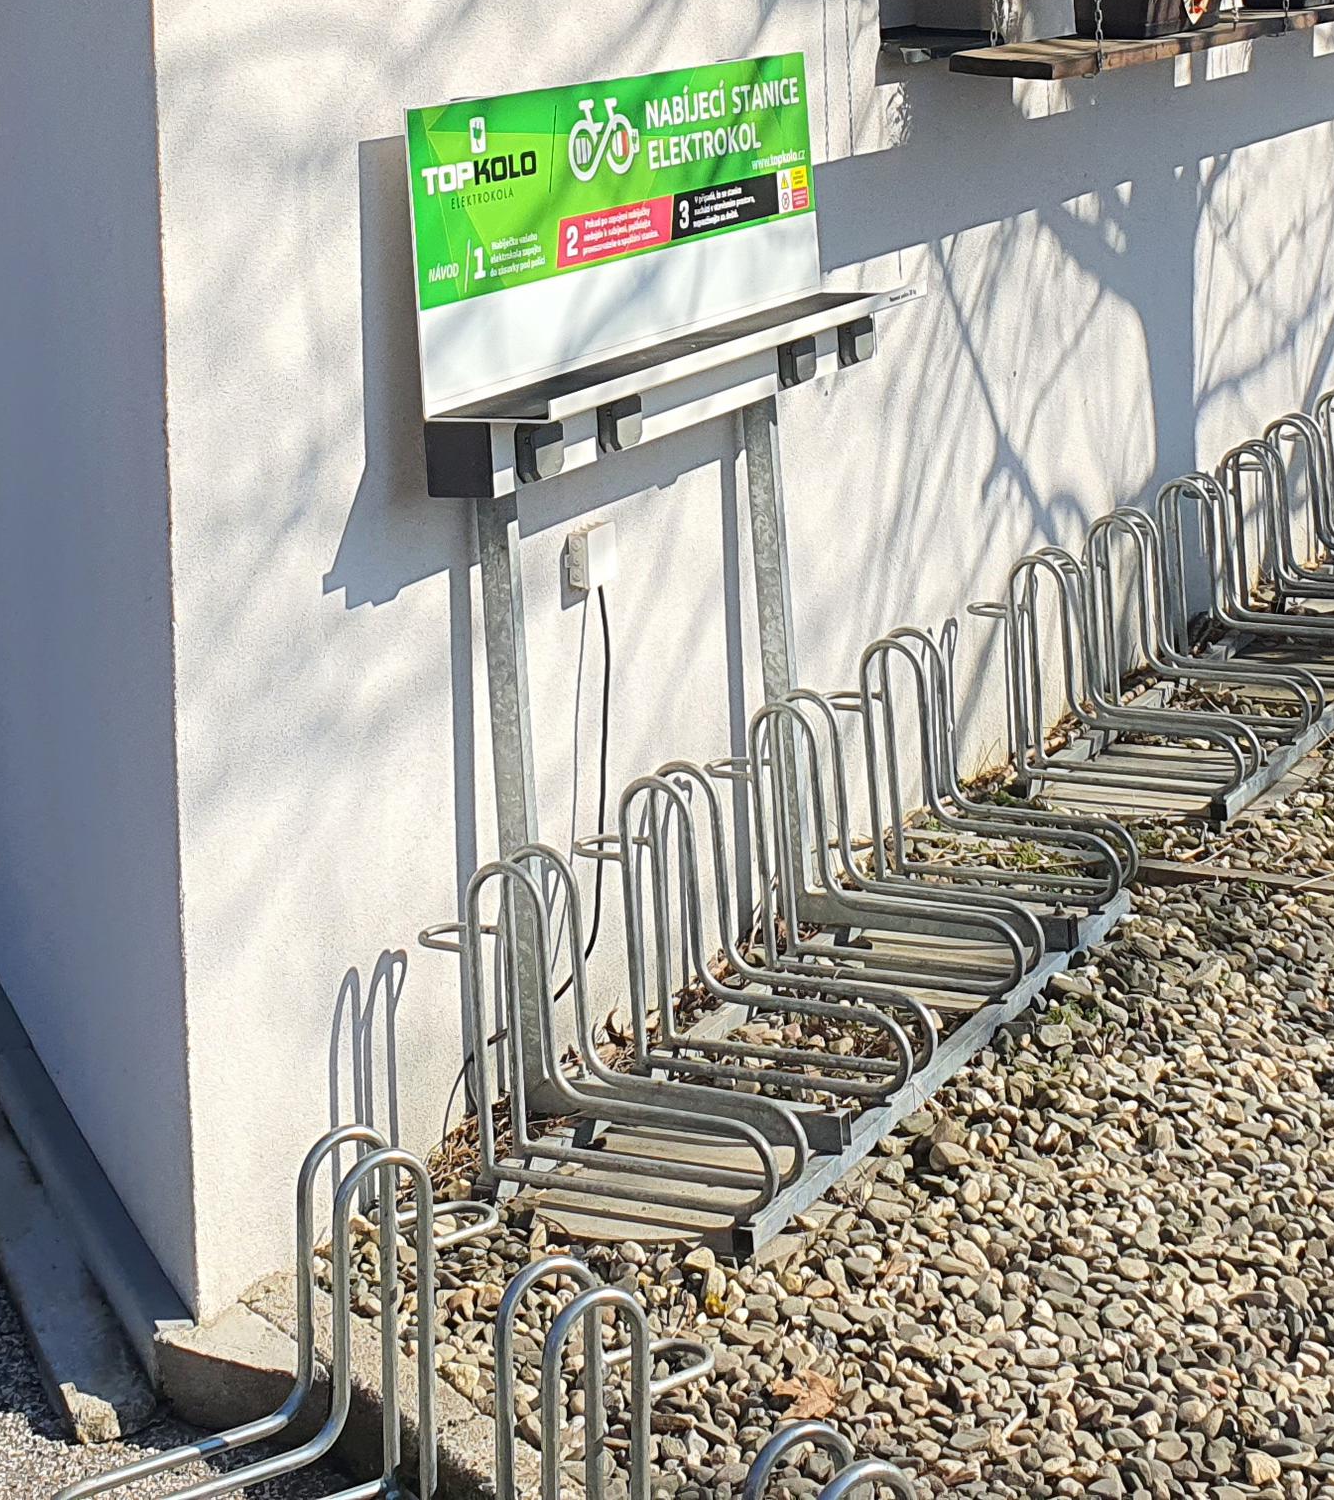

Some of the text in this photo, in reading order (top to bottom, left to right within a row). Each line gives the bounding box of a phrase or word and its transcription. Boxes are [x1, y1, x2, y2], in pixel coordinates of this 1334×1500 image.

[645, 77, 800, 129] NABÍJECÍ STANICE
[647, 122, 762, 170] ELEKTROKOL
[751, 148, 806, 170] www.topkolo.cz
[421, 150, 537, 196] TOPKOLO
[451, 187, 514, 210] ELEKTROKOLA
[679, 199, 690, 229] 3
[566, 225, 579, 257] 2
[428, 262, 460, 283] NÁVOD
[473, 246, 487, 280] 1
